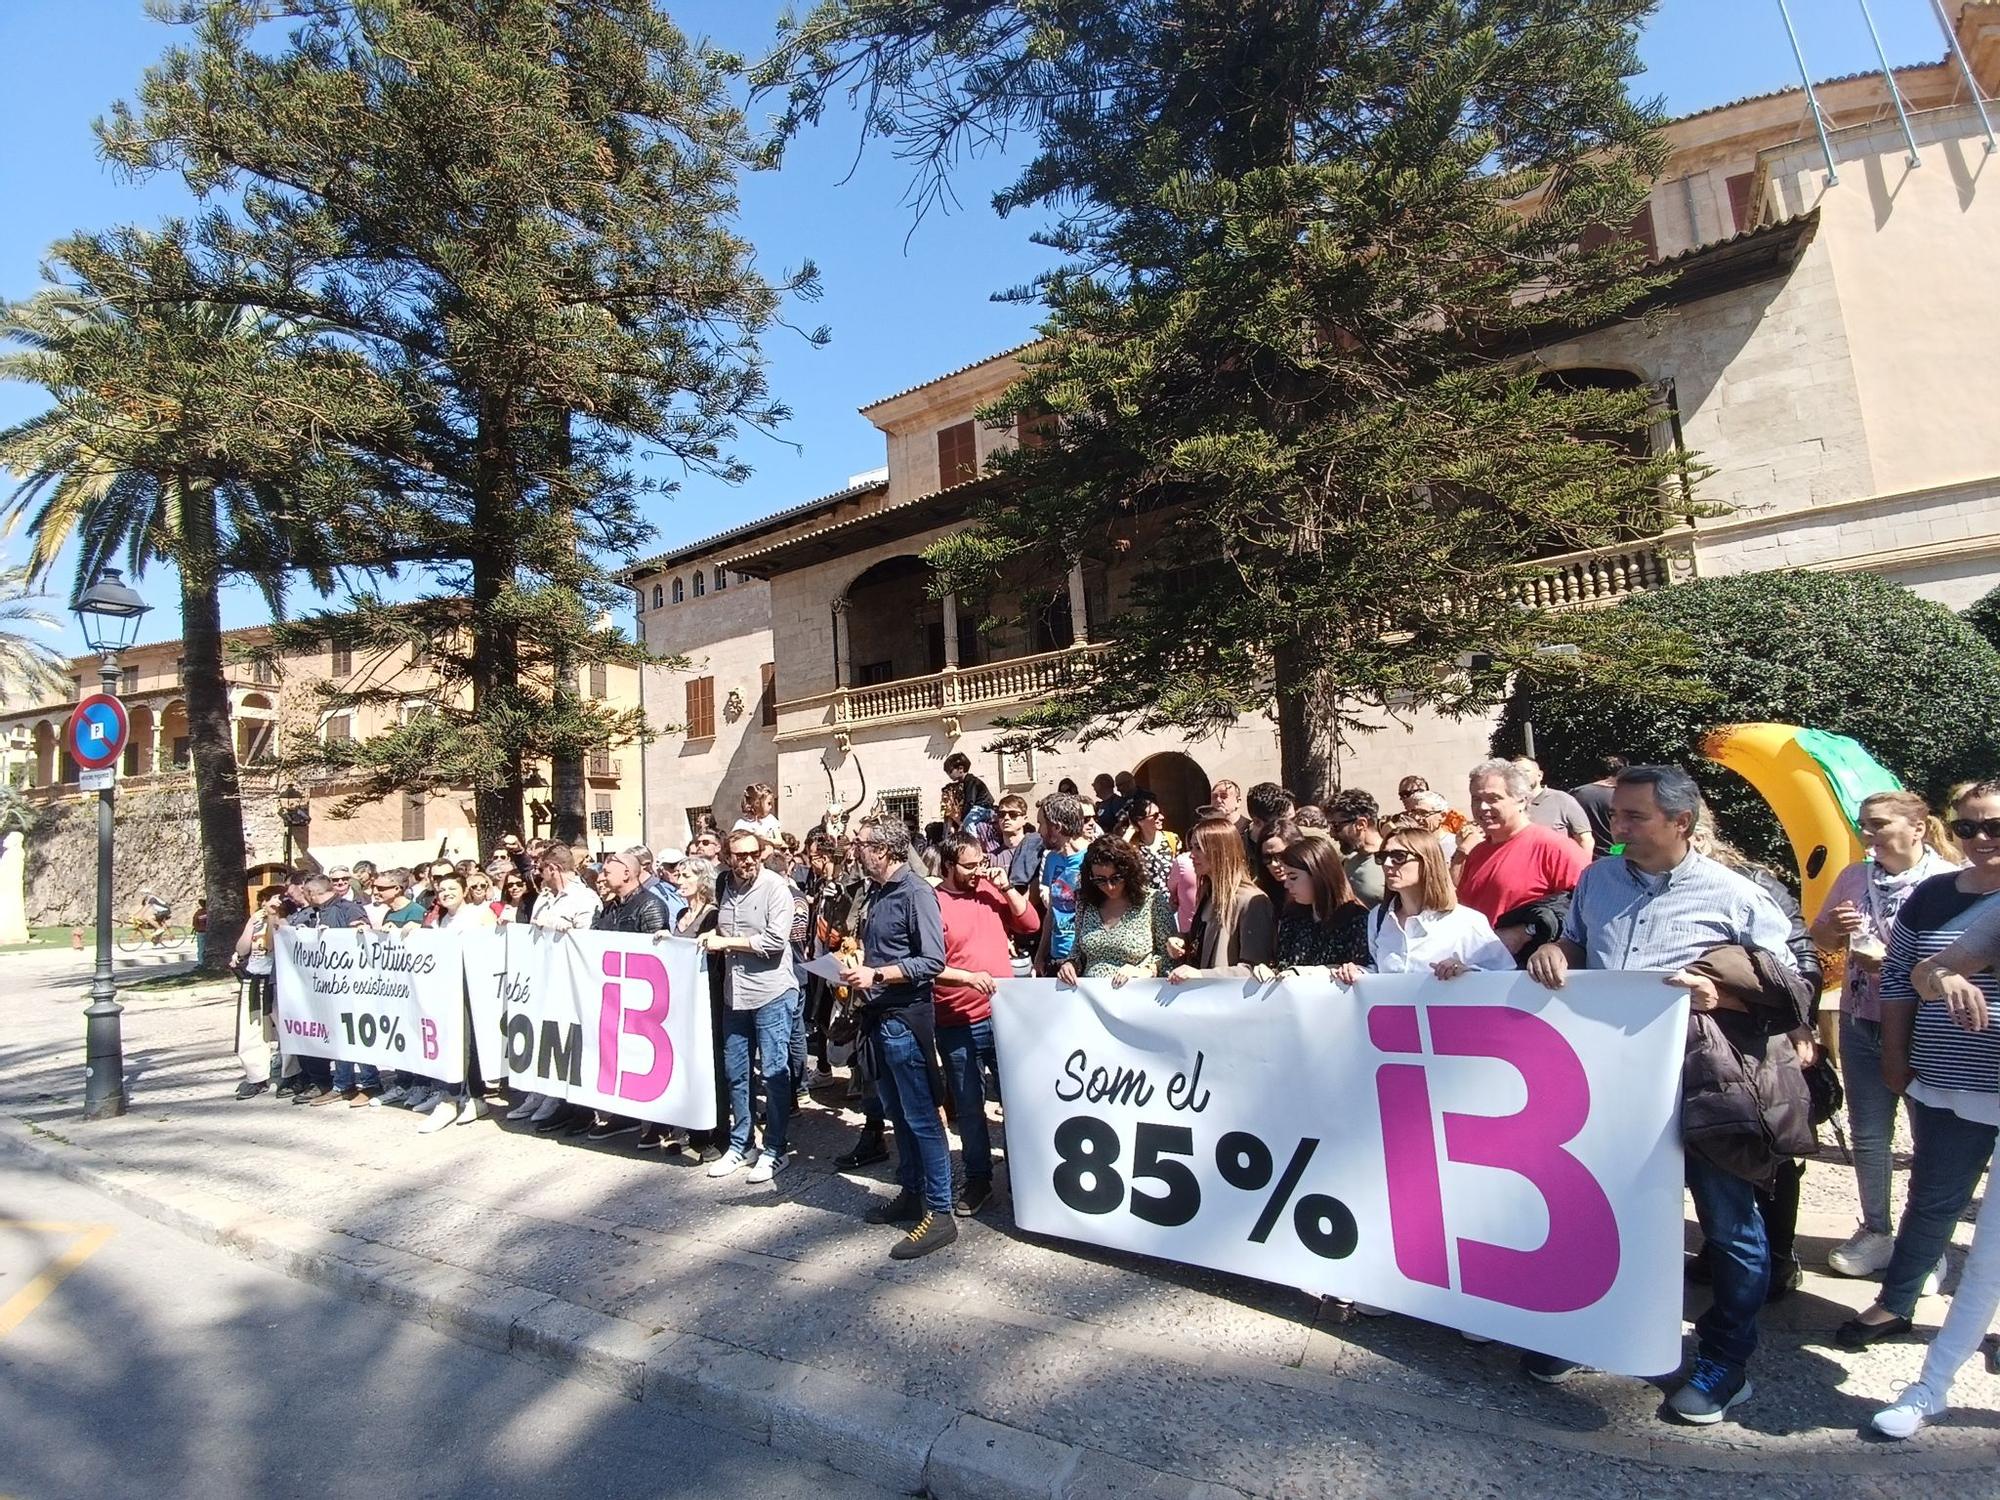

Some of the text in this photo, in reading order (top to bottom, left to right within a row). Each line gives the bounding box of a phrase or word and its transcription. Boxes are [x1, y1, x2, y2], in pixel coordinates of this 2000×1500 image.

[293, 941, 354, 970] Menorca
[359, 944, 368, 970] i
[312, 972, 350, 995] també
[284, 1019, 328, 1038] VOLEM
[340, 1012, 406, 1052] 10%
[1055, 1049, 1211, 1113] Som el
[1053, 1115, 1359, 1260] 85%
